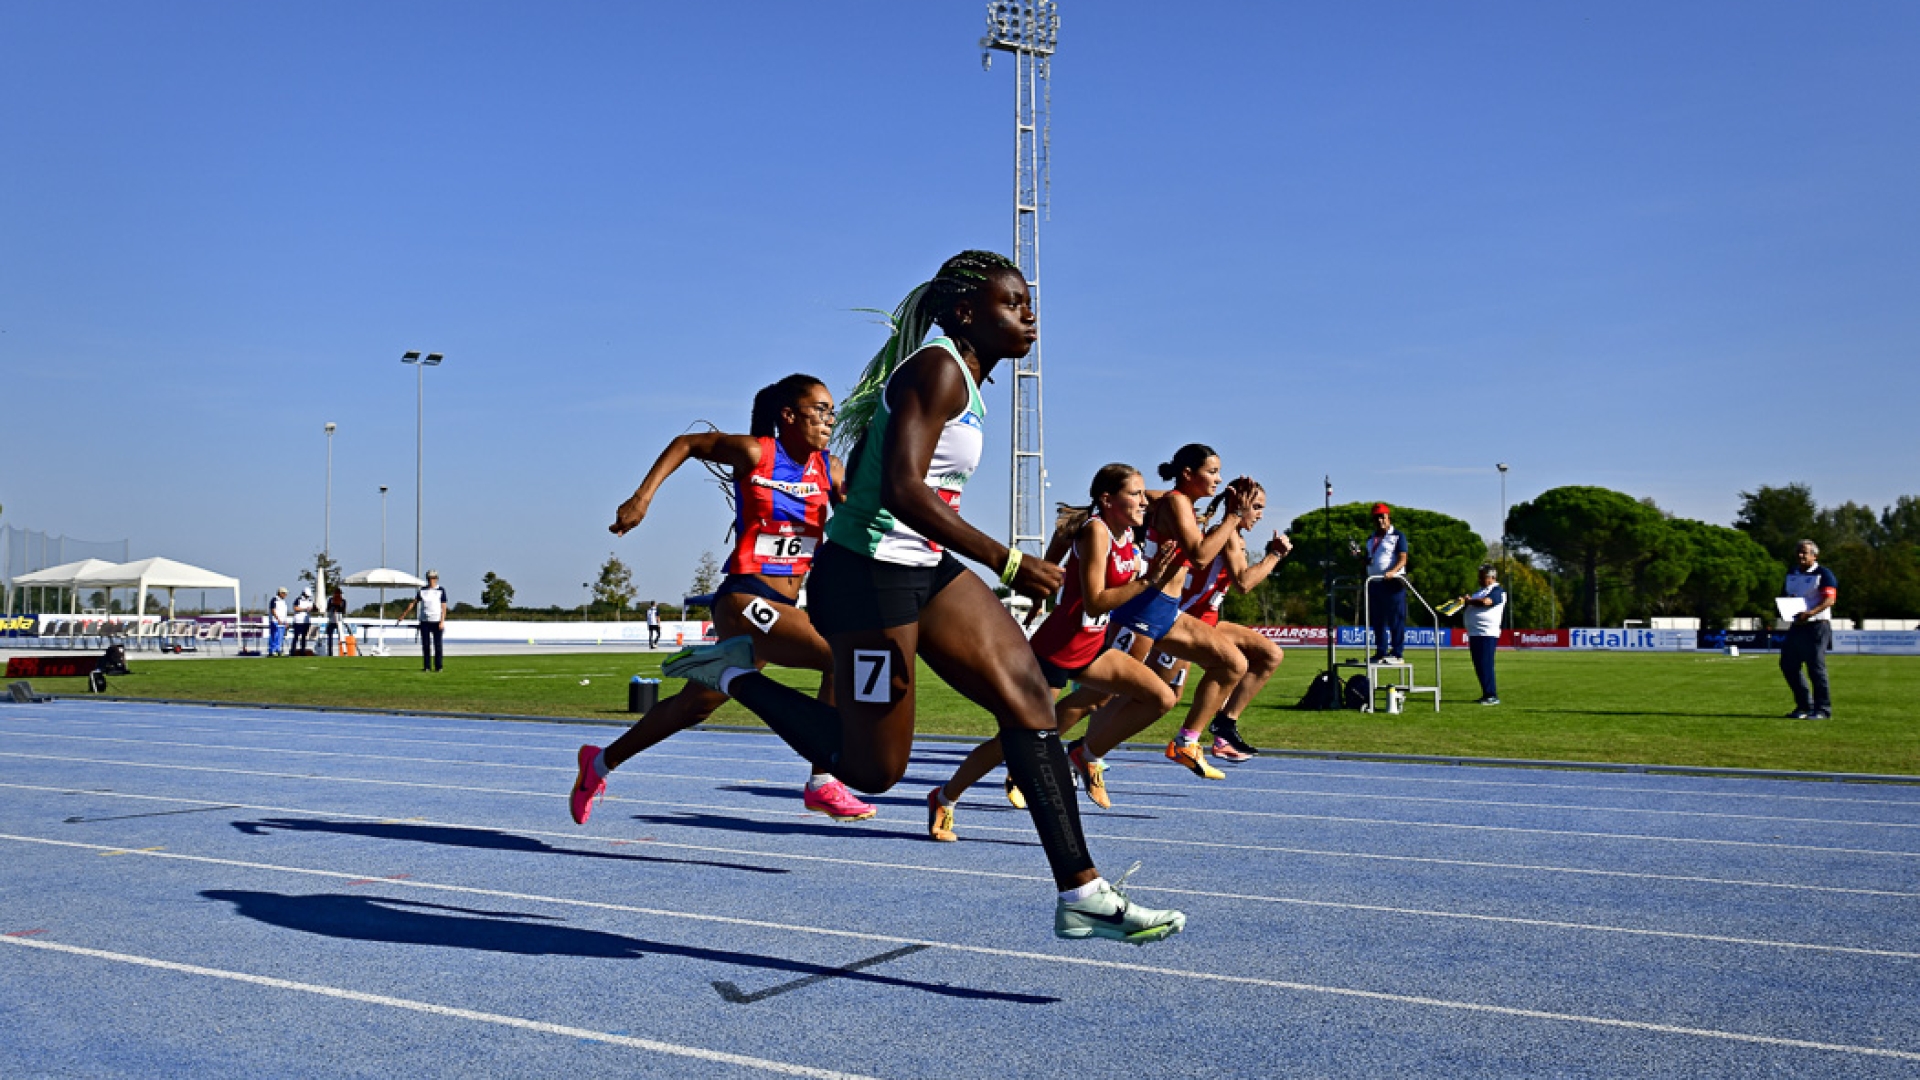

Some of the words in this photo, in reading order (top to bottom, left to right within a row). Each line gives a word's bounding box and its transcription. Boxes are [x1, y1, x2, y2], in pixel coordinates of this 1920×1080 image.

[774, 537, 802, 556] 16
[751, 602, 774, 625] 6
[1571, 630, 1655, 648] fidal.it
[858, 655, 886, 695] 7
